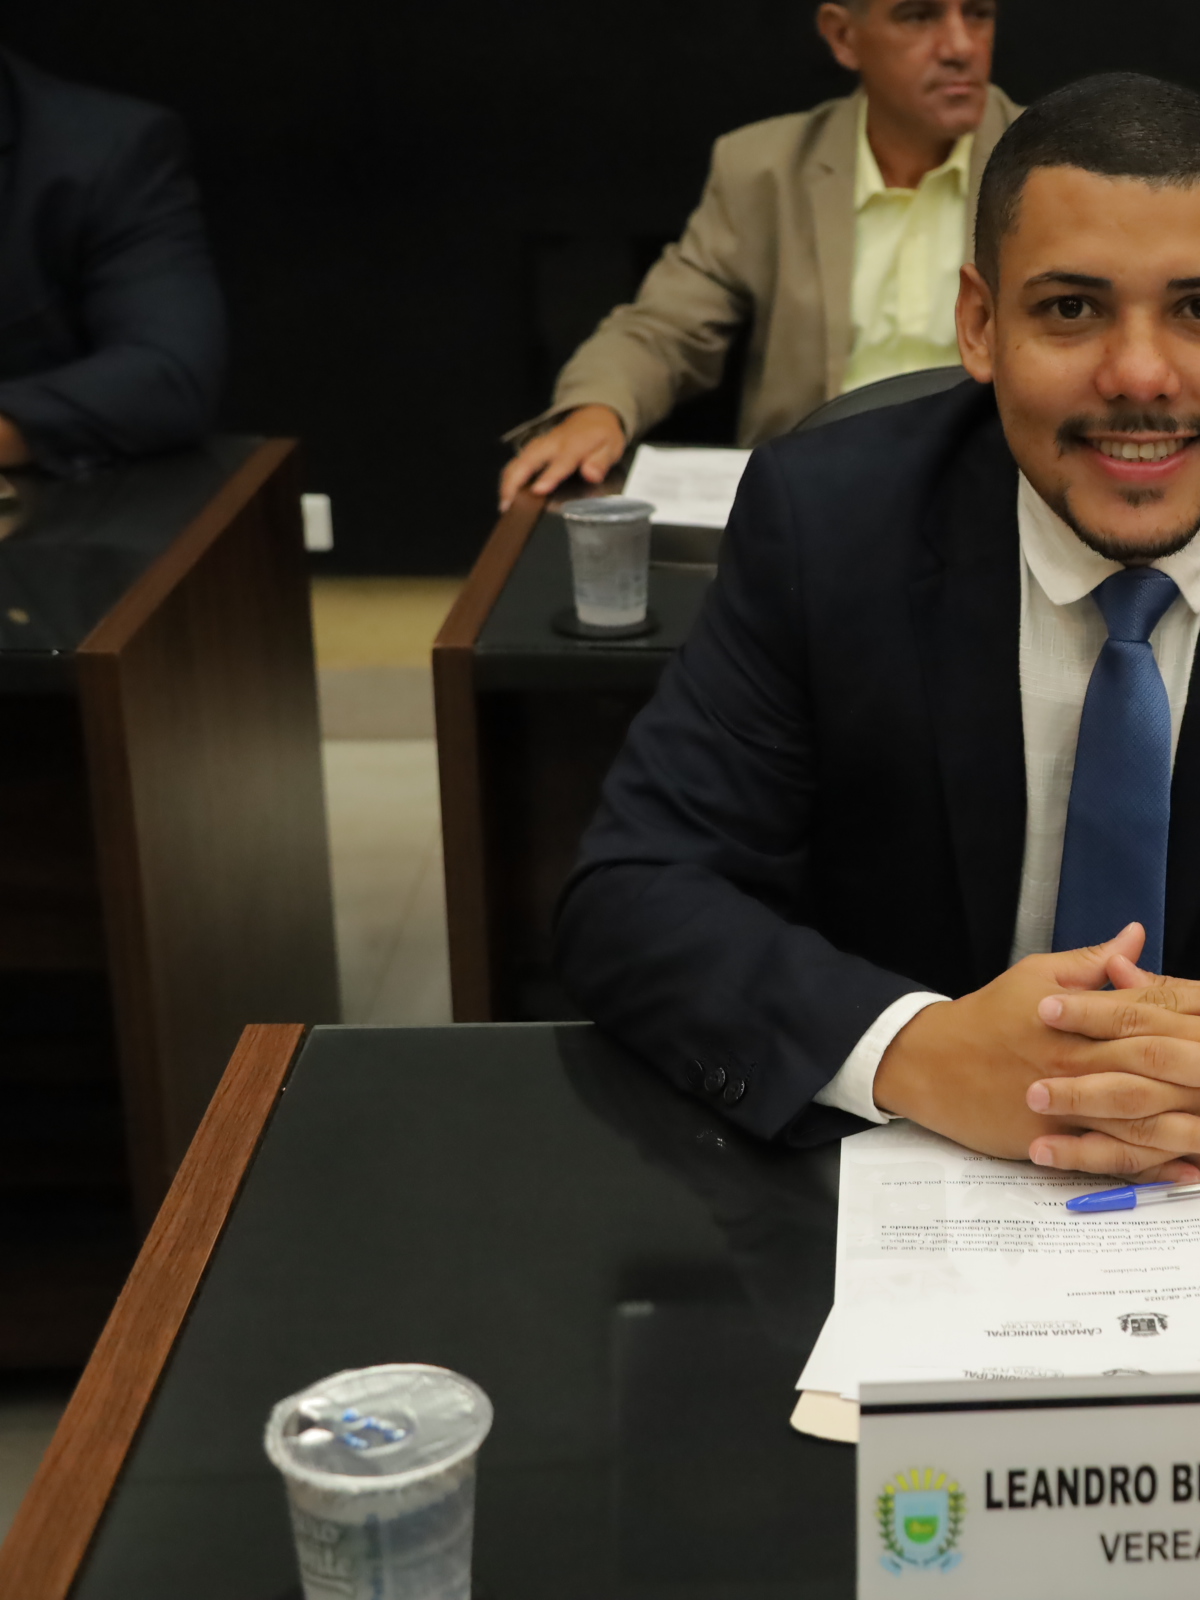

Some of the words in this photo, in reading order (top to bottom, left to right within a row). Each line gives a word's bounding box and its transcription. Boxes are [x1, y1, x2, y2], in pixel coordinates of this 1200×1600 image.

[984, 1329, 1048, 1337] MUNICIPAL
[1051, 1327, 1102, 1336] CÂMARA
[962, 1370, 1027, 1381] UNICIPAL
[984, 1463, 1158, 1511] LEANDRO
